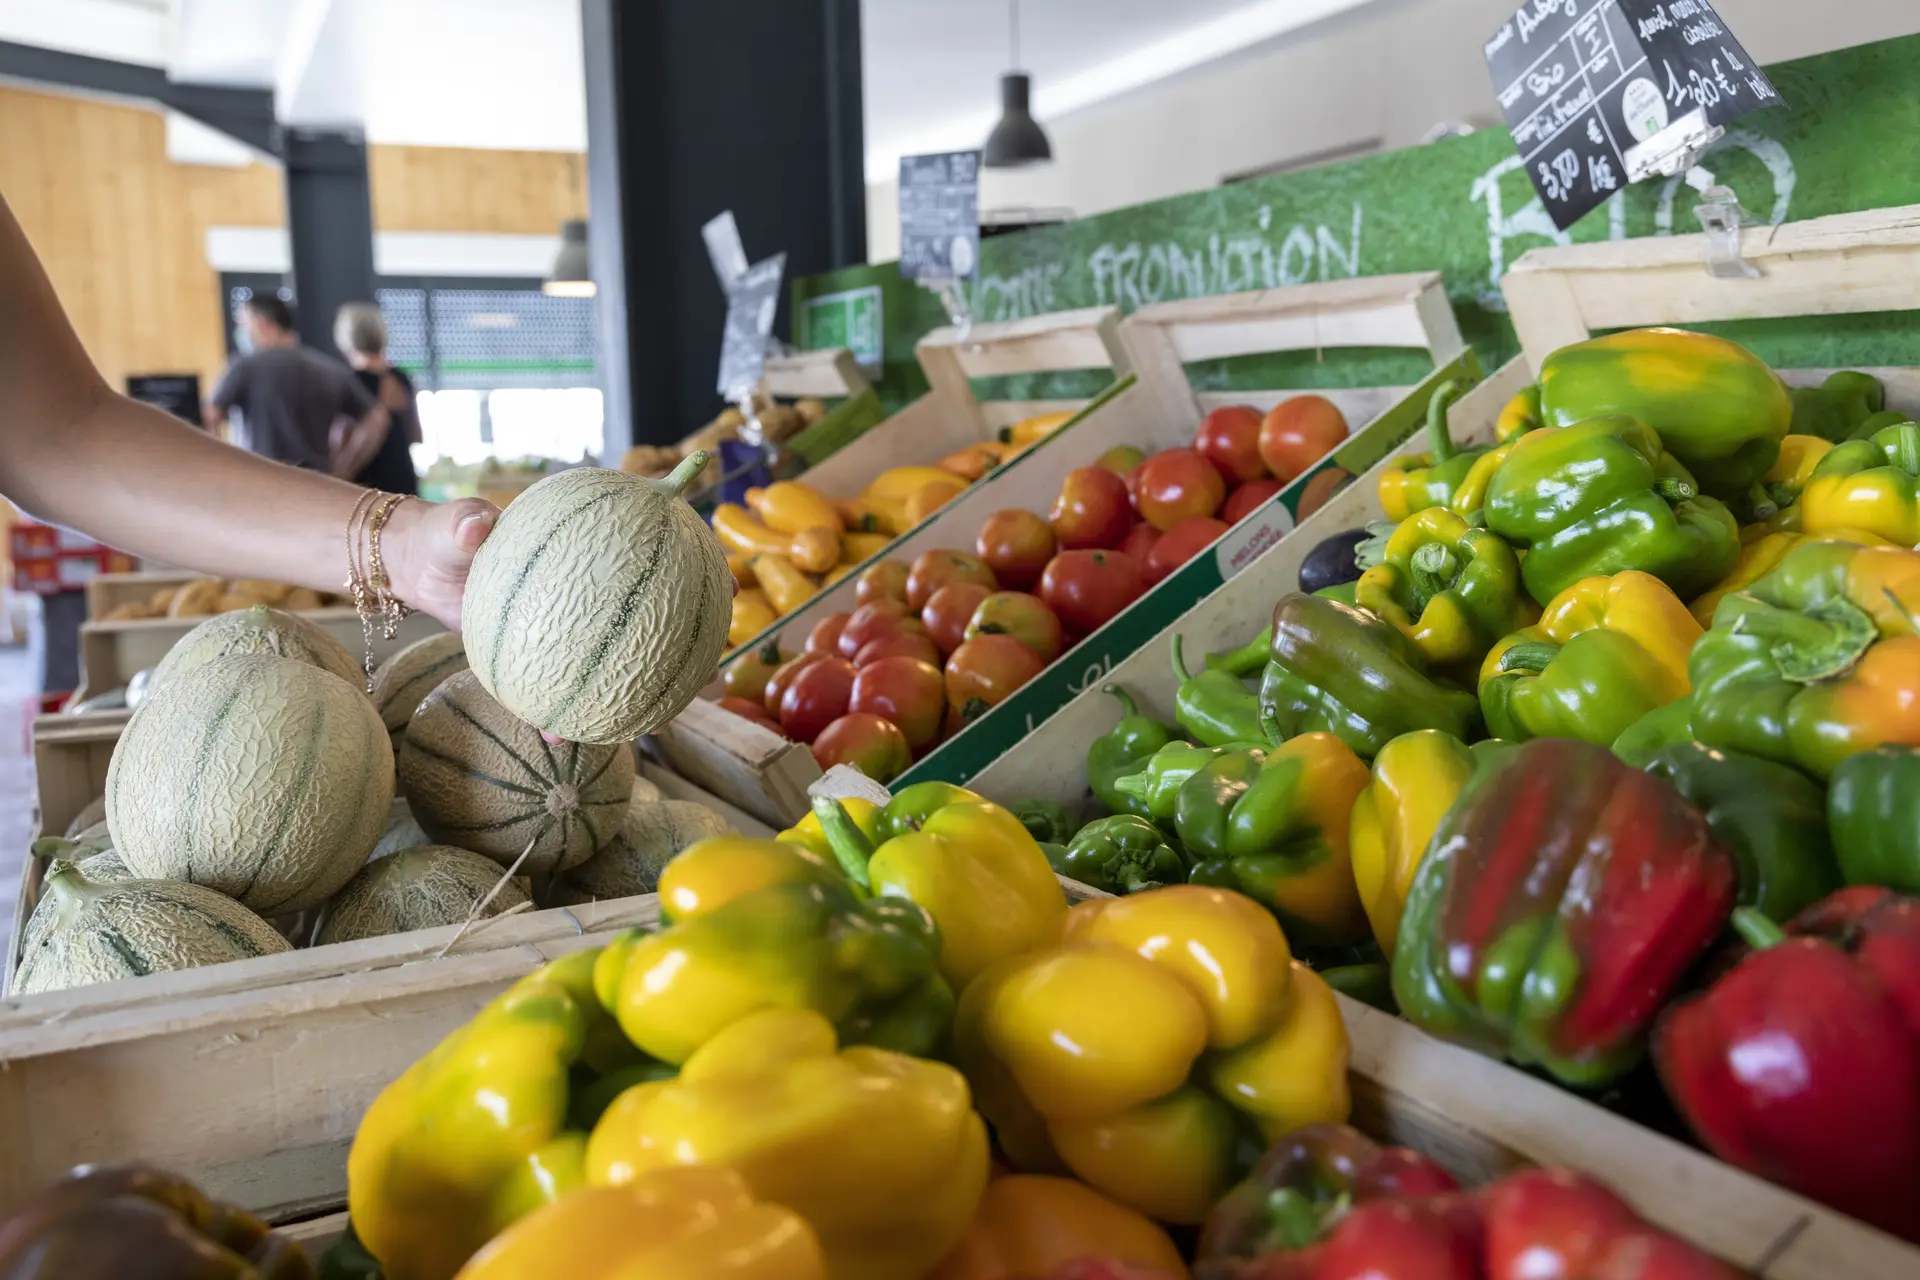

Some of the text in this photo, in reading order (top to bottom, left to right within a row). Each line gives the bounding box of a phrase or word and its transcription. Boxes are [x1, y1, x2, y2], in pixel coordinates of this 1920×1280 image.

[1527, 63, 1565, 97] Bio
[1663, 59, 1720, 107] 1,20
[1711, 58, 1737, 96] €
